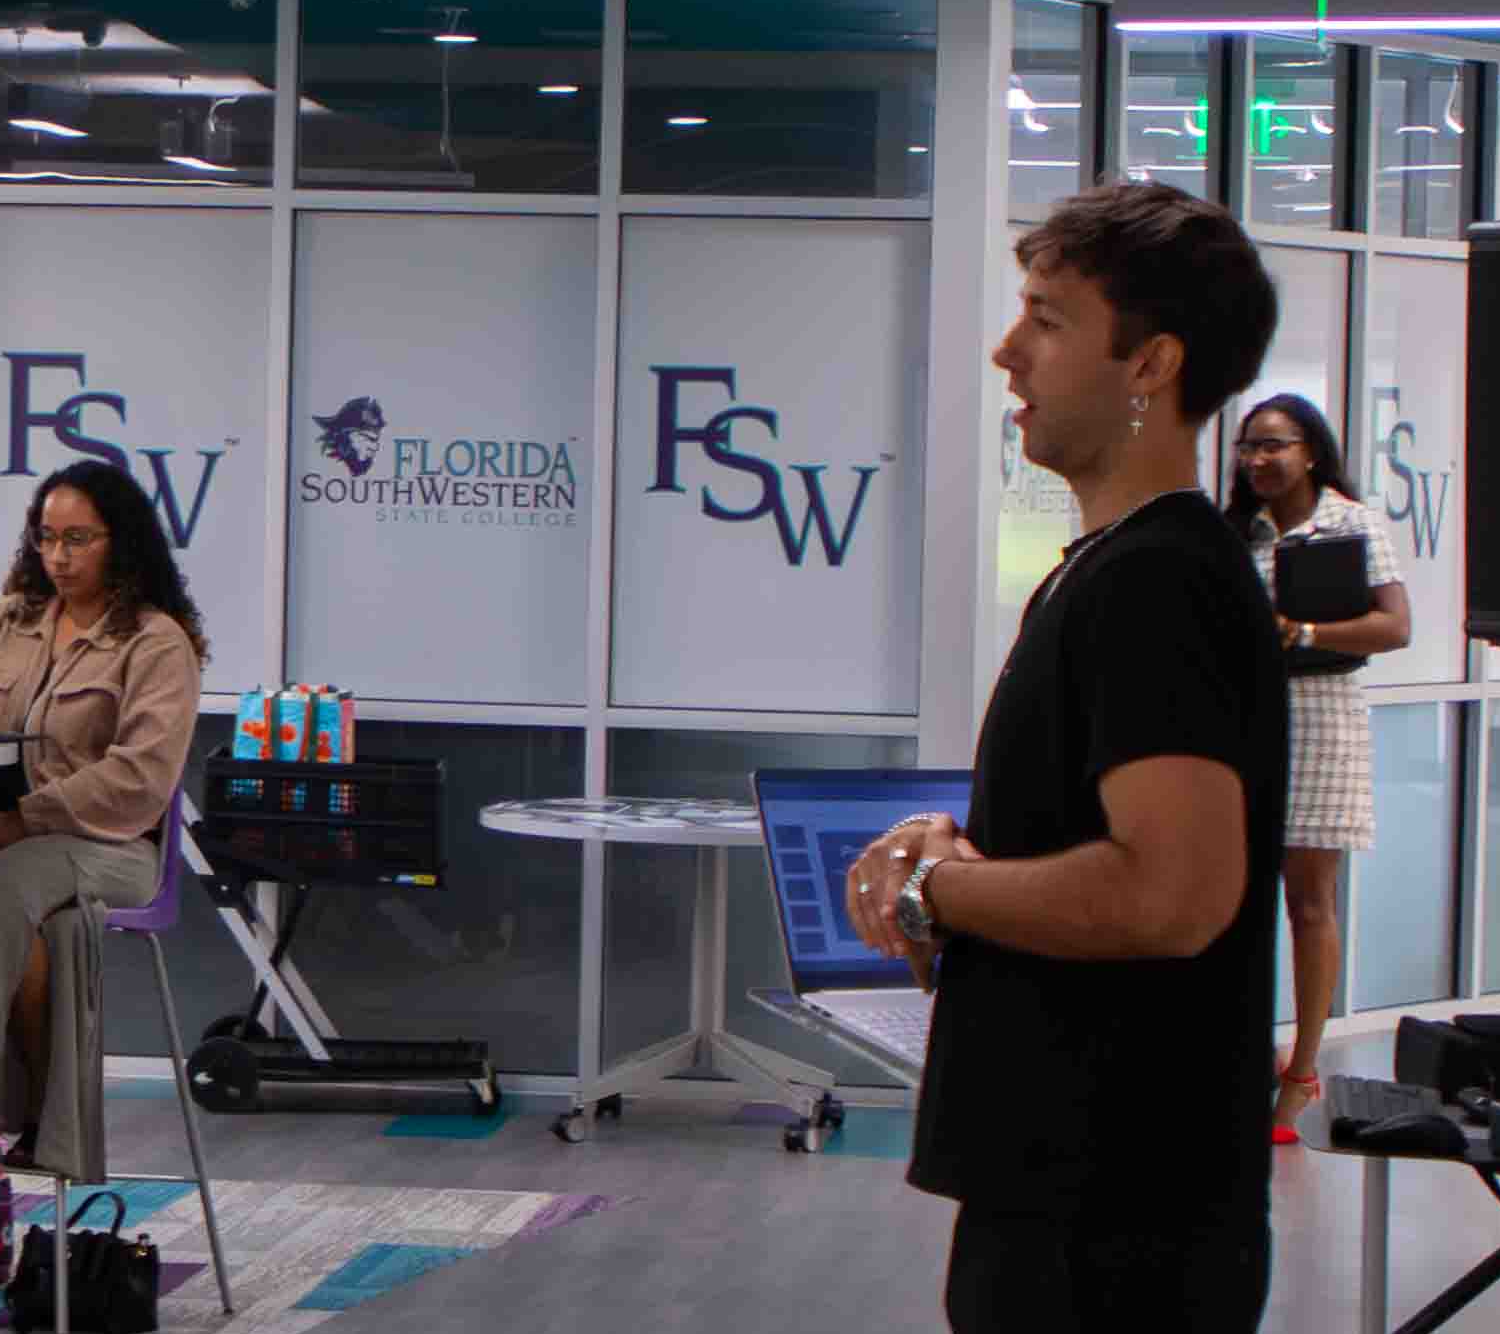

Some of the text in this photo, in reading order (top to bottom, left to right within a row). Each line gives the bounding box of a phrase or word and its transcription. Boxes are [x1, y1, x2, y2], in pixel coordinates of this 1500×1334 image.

[0, 351, 227, 550] FSW
[375, 507, 578, 528] STATE COLLEGE
[393, 437, 578, 484] FLORIDA
[644, 364, 880, 568] FSW
[1368, 386, 1451, 560] FSW
